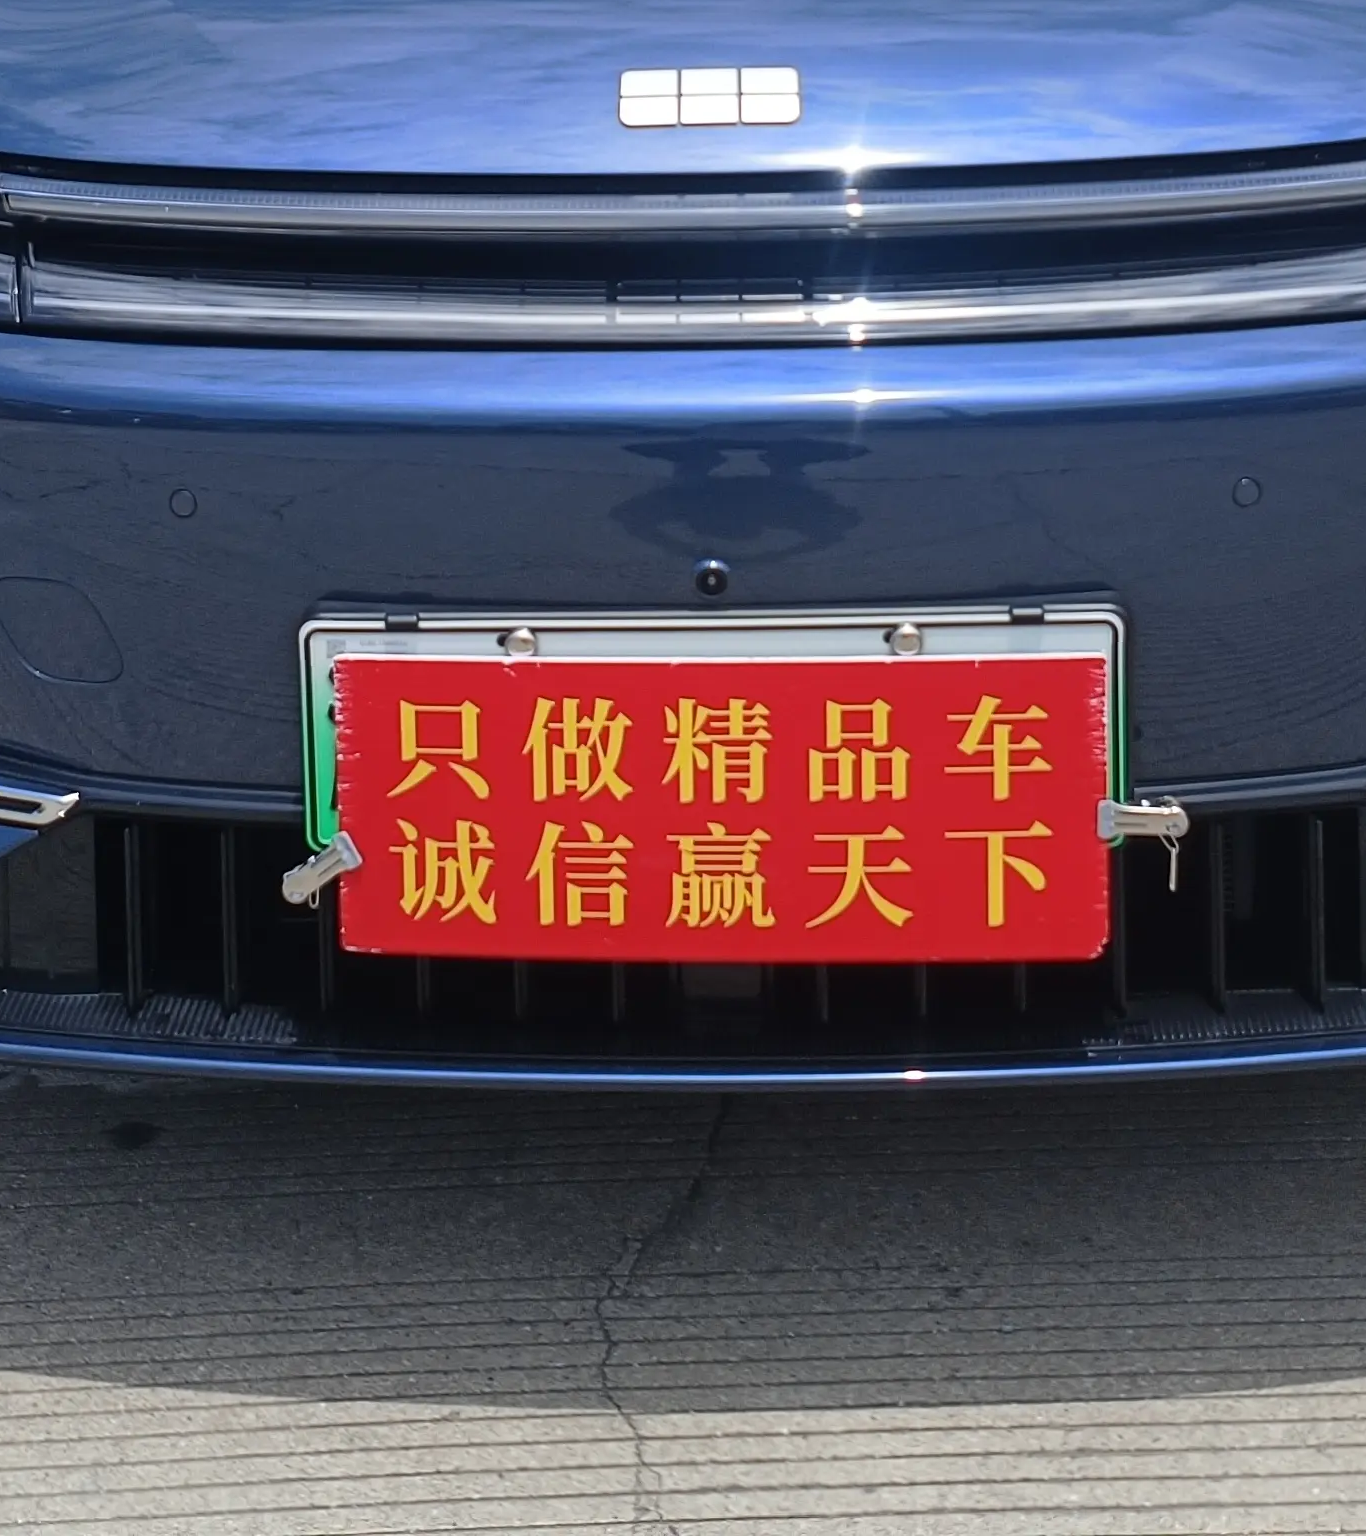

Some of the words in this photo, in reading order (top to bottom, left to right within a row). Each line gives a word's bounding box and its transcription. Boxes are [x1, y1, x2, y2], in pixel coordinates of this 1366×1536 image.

[385, 695, 1053, 804] 只做精品车
[387, 821, 1052, 930] 诚信赢天下
